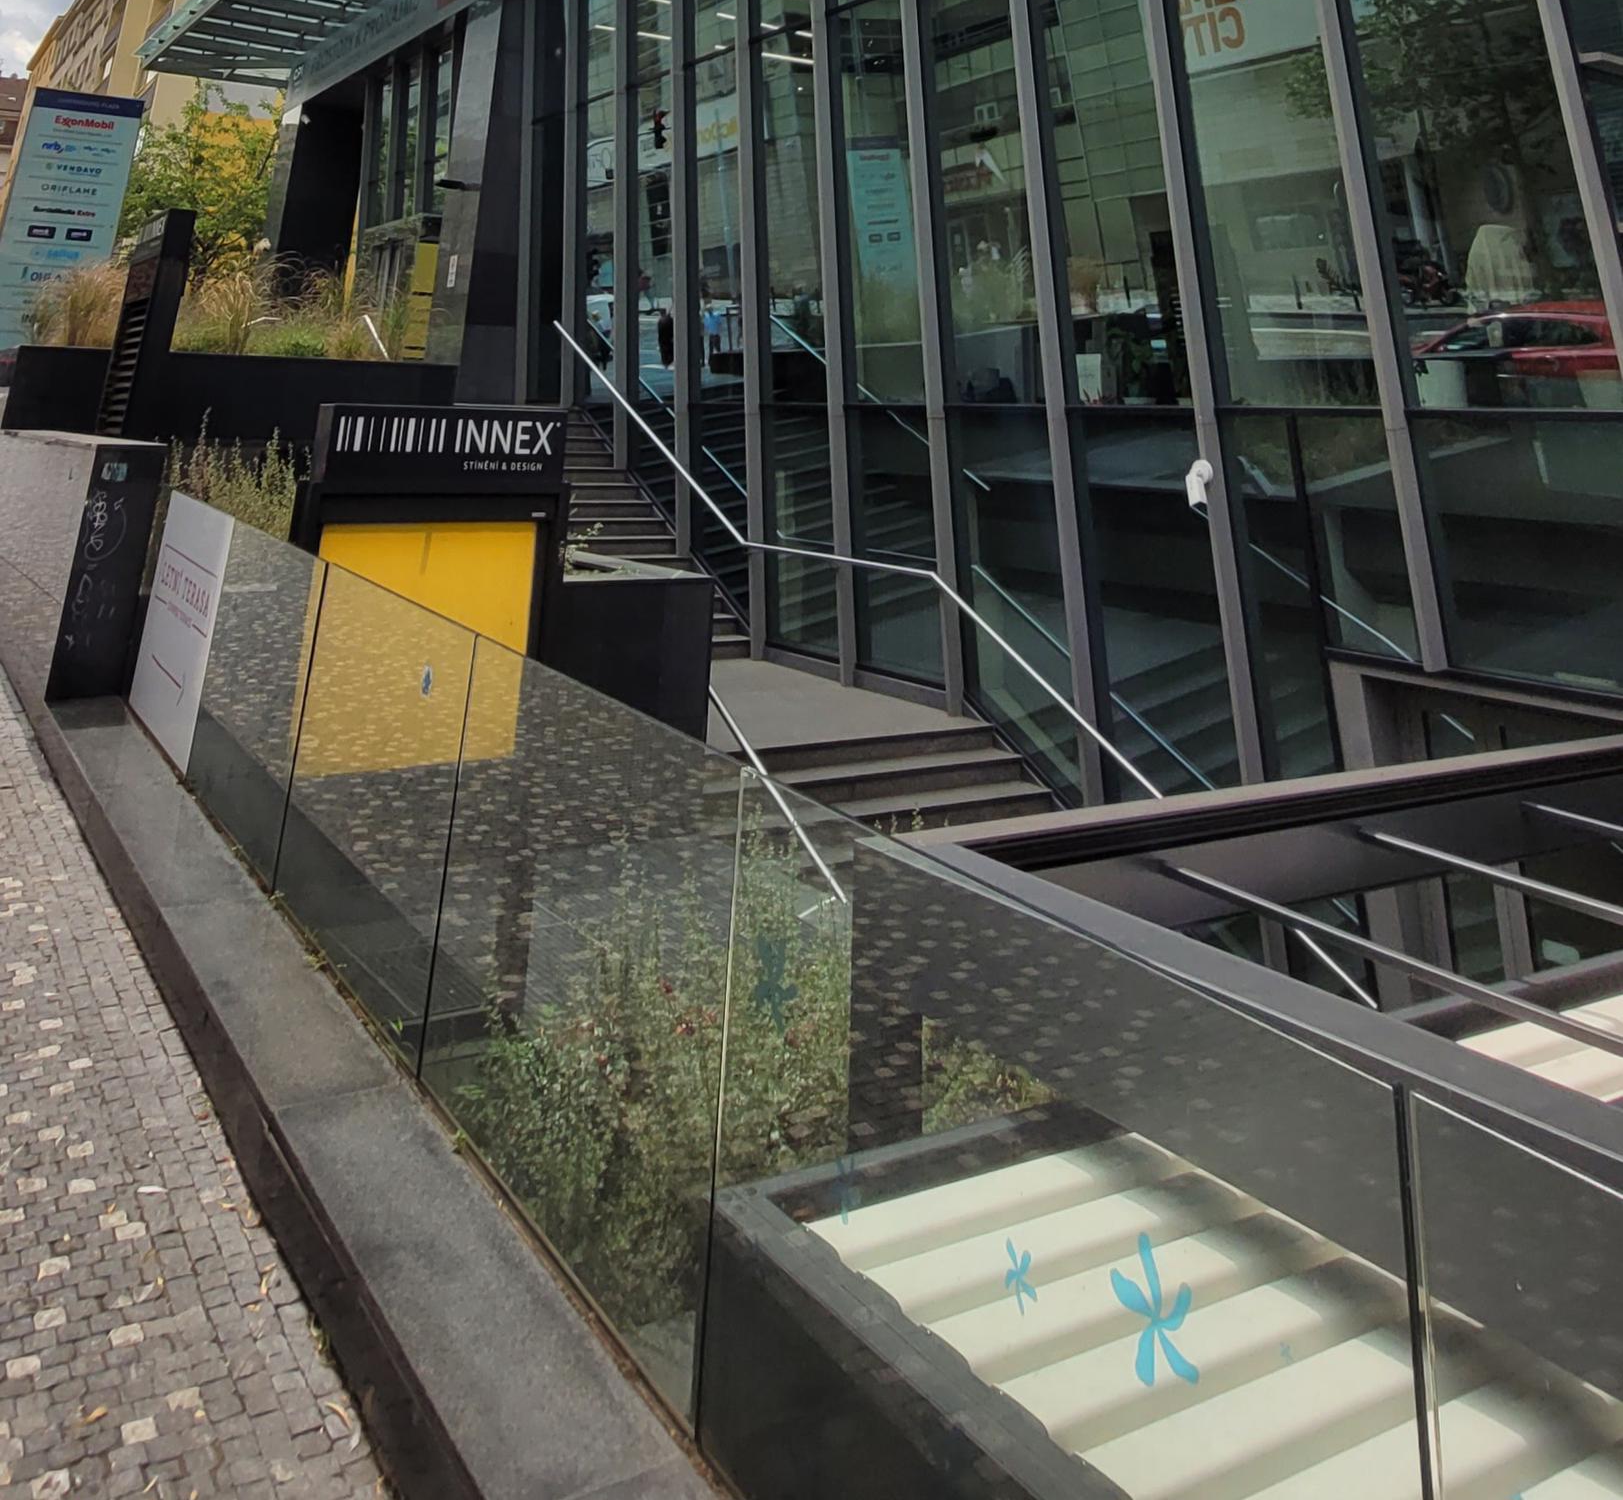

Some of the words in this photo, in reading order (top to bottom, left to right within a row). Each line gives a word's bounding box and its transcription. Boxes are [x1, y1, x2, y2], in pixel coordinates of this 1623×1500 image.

[54, 115, 115, 130] ExxonMobil
[57, 164, 103, 175] VENDAVO
[41, 183, 98, 196] ORIFLAME
[454, 418, 555, 455] INNEX
[501, 462, 507, 471] &
[510, 462, 543, 471] DESIGN
[160, 561, 184, 596] LETNÍ
[182, 577, 210, 618] TERASA
